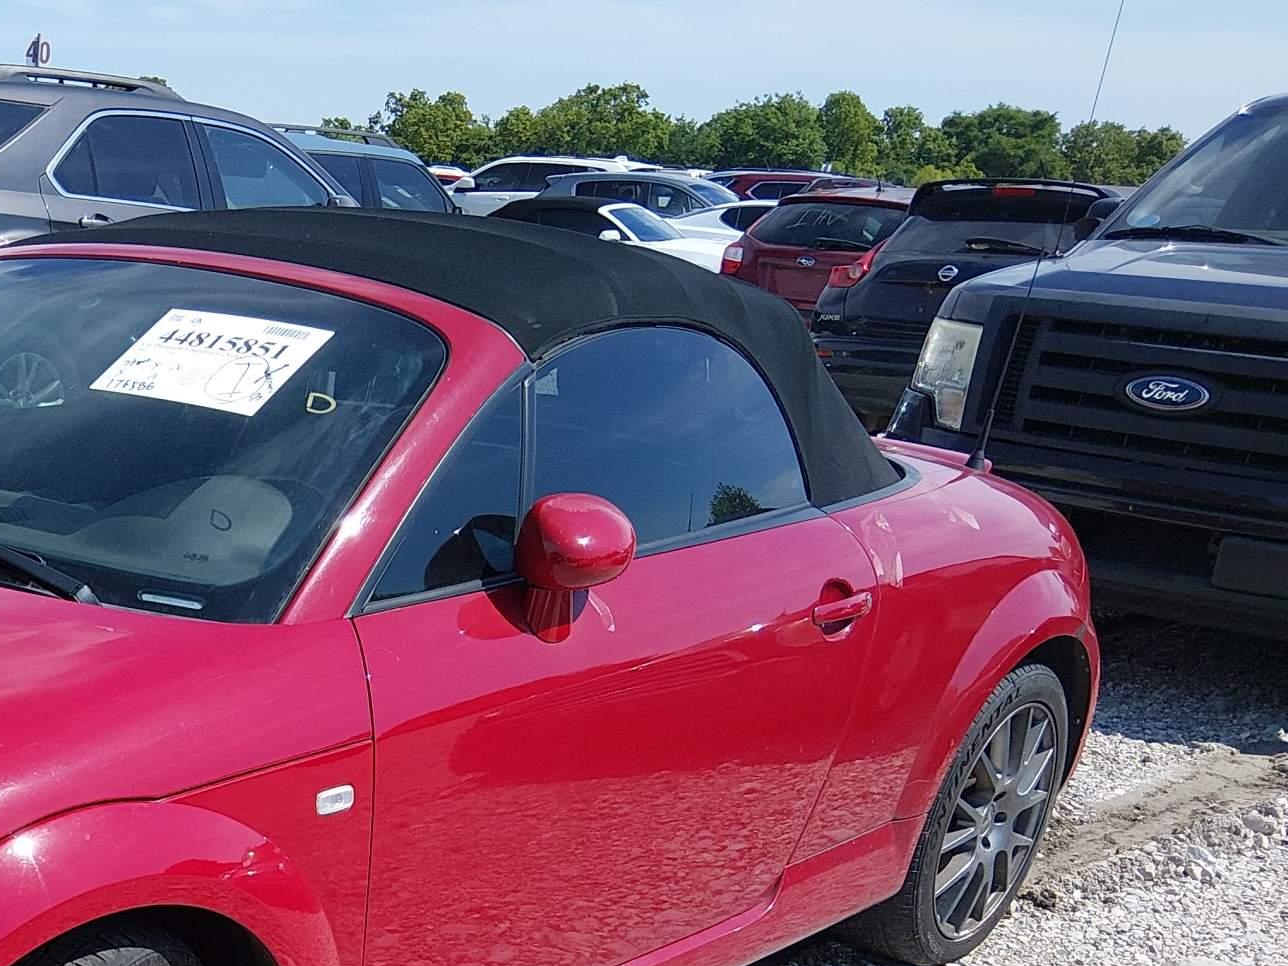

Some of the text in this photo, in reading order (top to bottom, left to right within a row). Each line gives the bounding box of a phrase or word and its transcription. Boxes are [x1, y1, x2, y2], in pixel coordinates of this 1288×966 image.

[25, 40, 51, 64] 40
[816, 314, 841, 322] JUKE
[158, 328, 290, 360] 44815851
[1141, 380, 1190, 402] Ford
